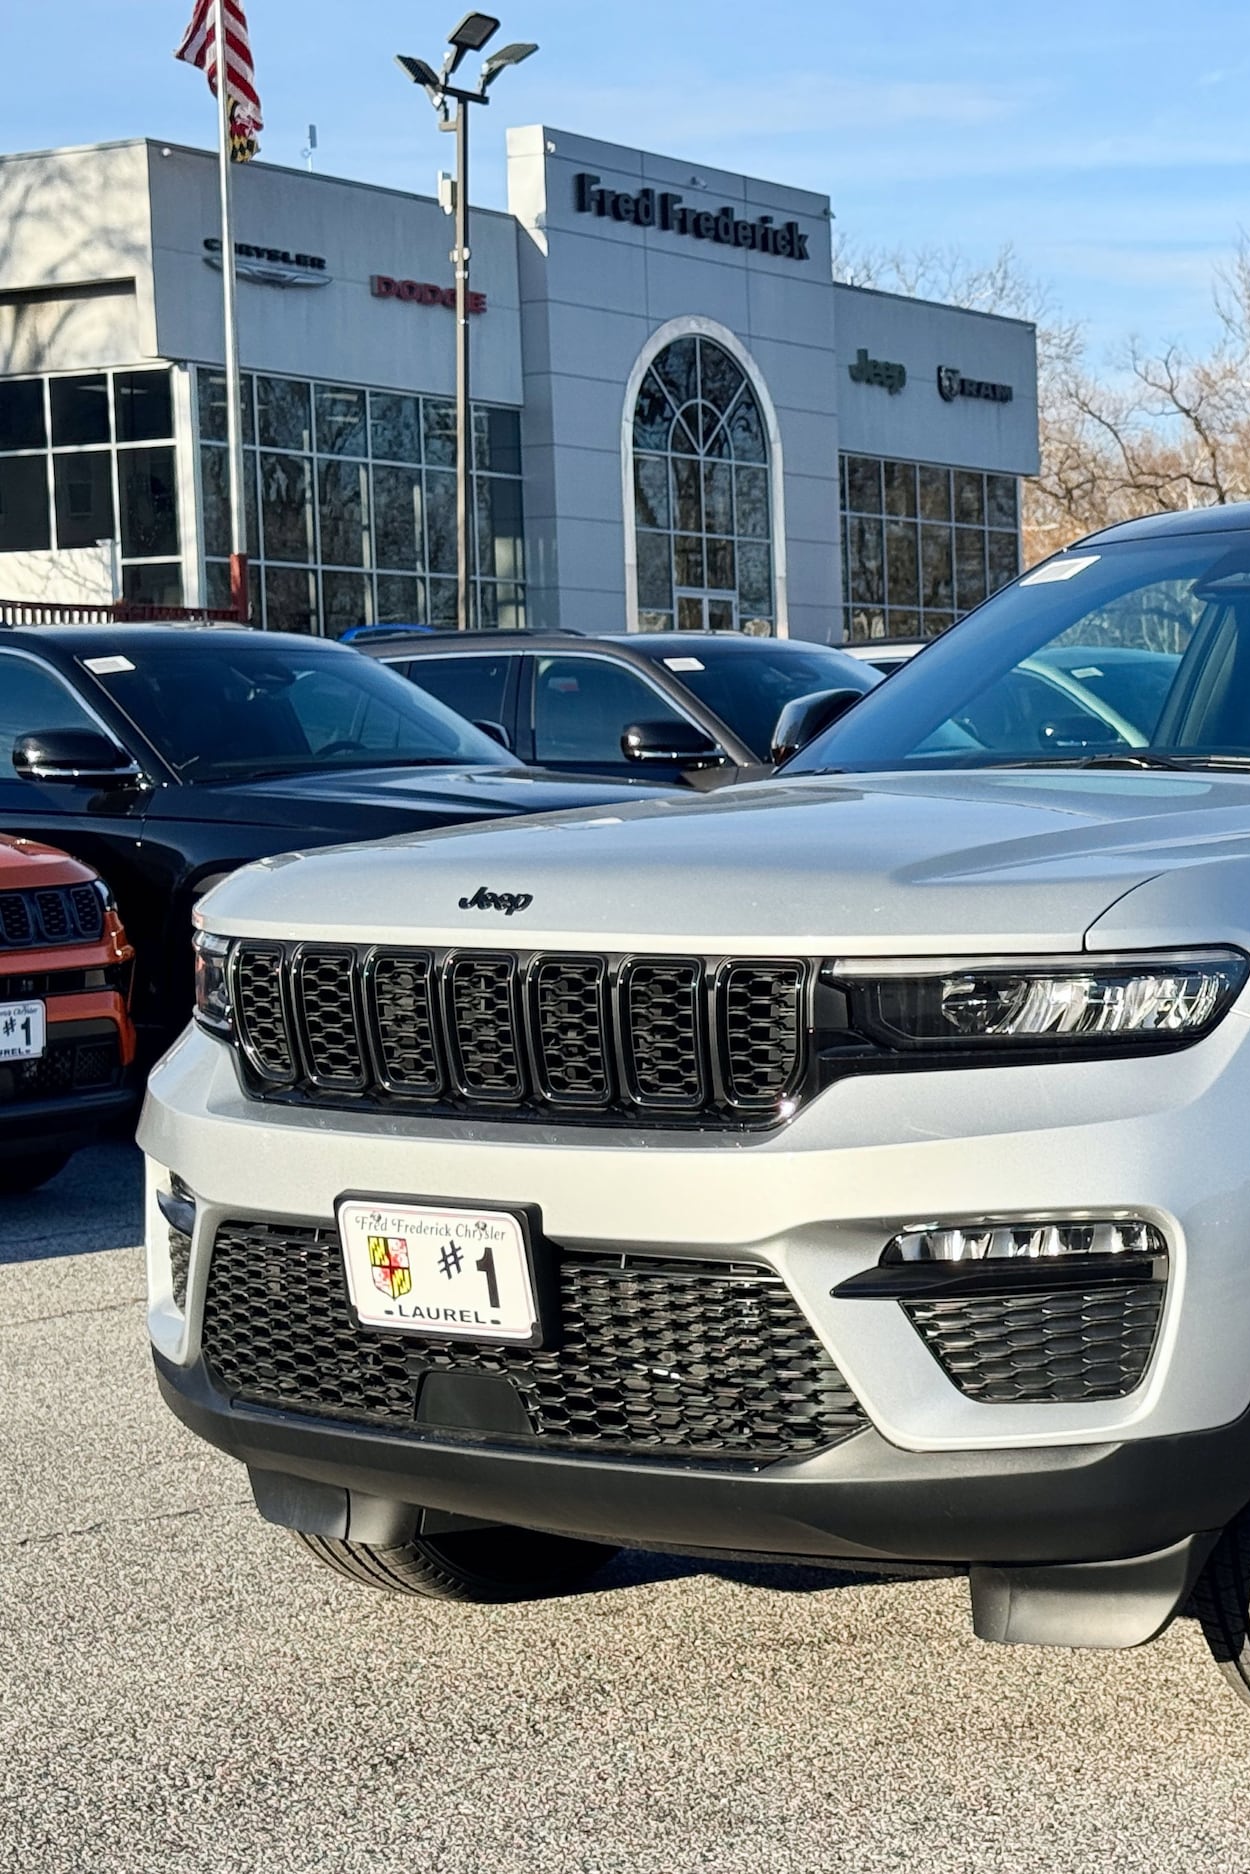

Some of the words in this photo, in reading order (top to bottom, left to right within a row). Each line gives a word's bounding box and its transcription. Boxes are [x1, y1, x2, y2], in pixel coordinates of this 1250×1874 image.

[575, 172, 655, 227] Fred
[658, 192, 810, 260] Frederick
[203, 238, 326, 270] CRYSLER
[848, 349, 906, 396] Jeep
[959, 370, 1013, 402] RAM
[458, 886, 534, 916] Jeep
[355, 1215, 388, 1232] Fred
[391, 1218, 452, 1237] Frederick
[455, 1223, 507, 1241] Chrysler
[398, 1304, 487, 1325] LAUREL
